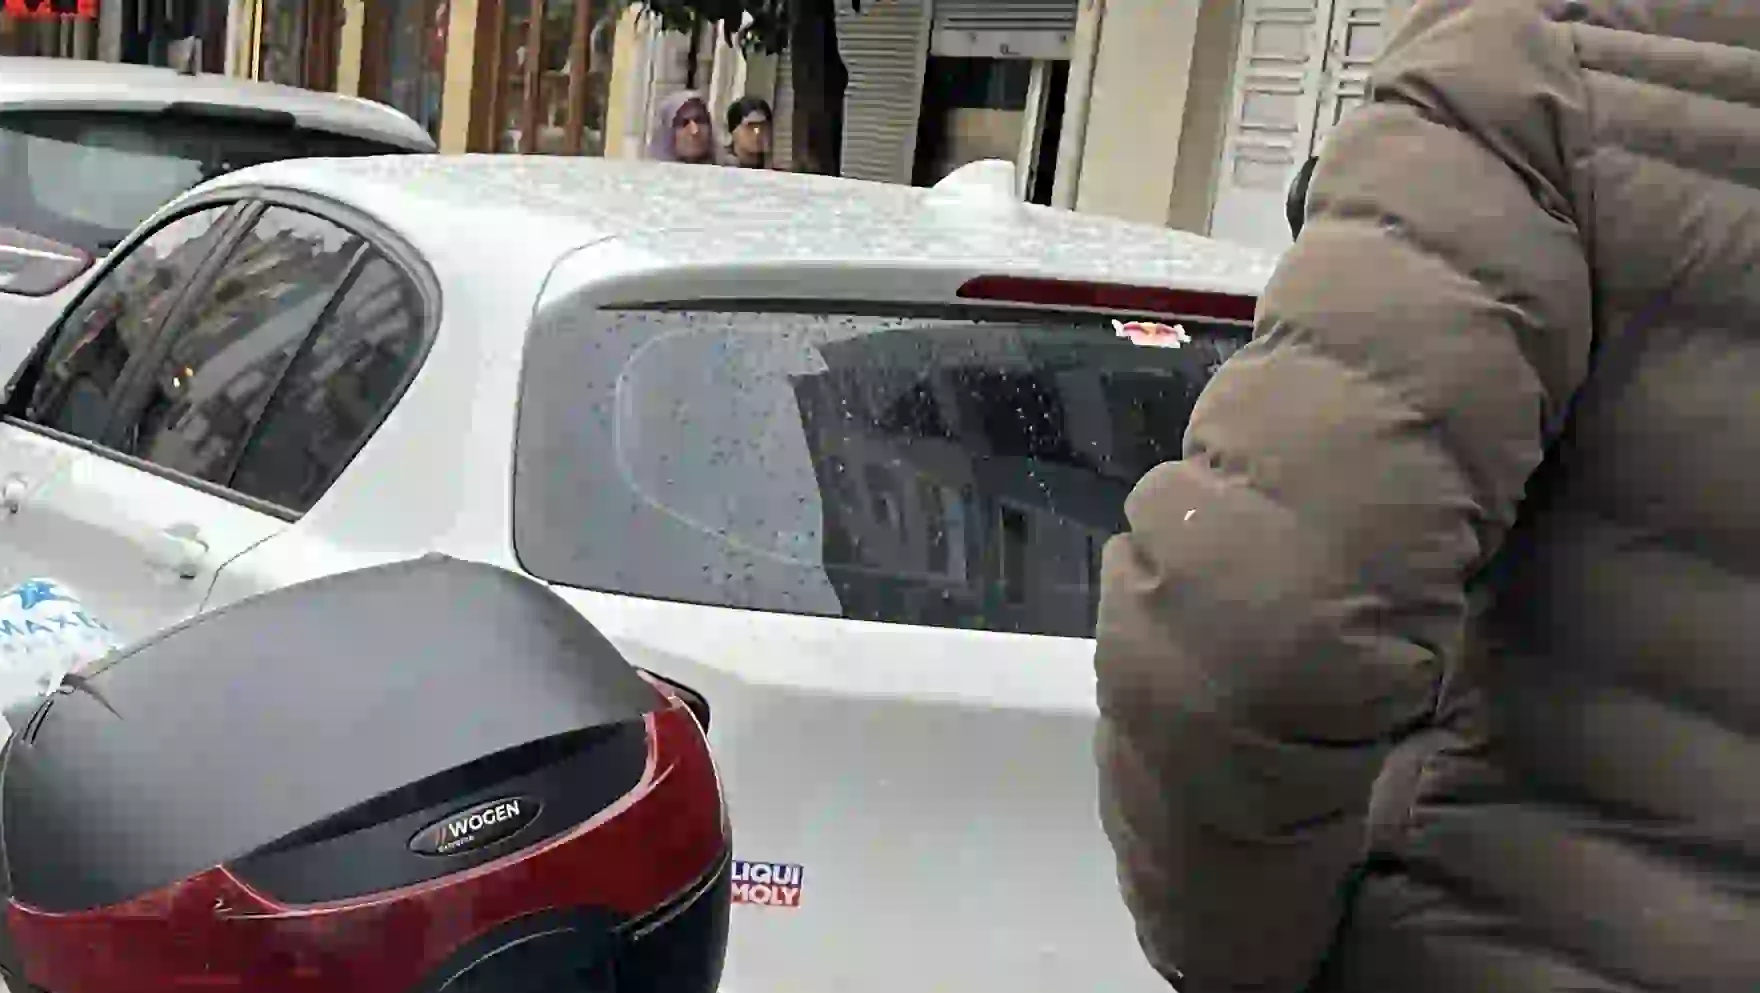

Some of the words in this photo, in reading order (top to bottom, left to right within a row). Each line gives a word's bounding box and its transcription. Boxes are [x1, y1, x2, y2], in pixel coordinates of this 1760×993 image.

[448, 800, 520, 837] WOGEN
[731, 862, 800, 885] LIQUI
[731, 883, 799, 905] MOLY
